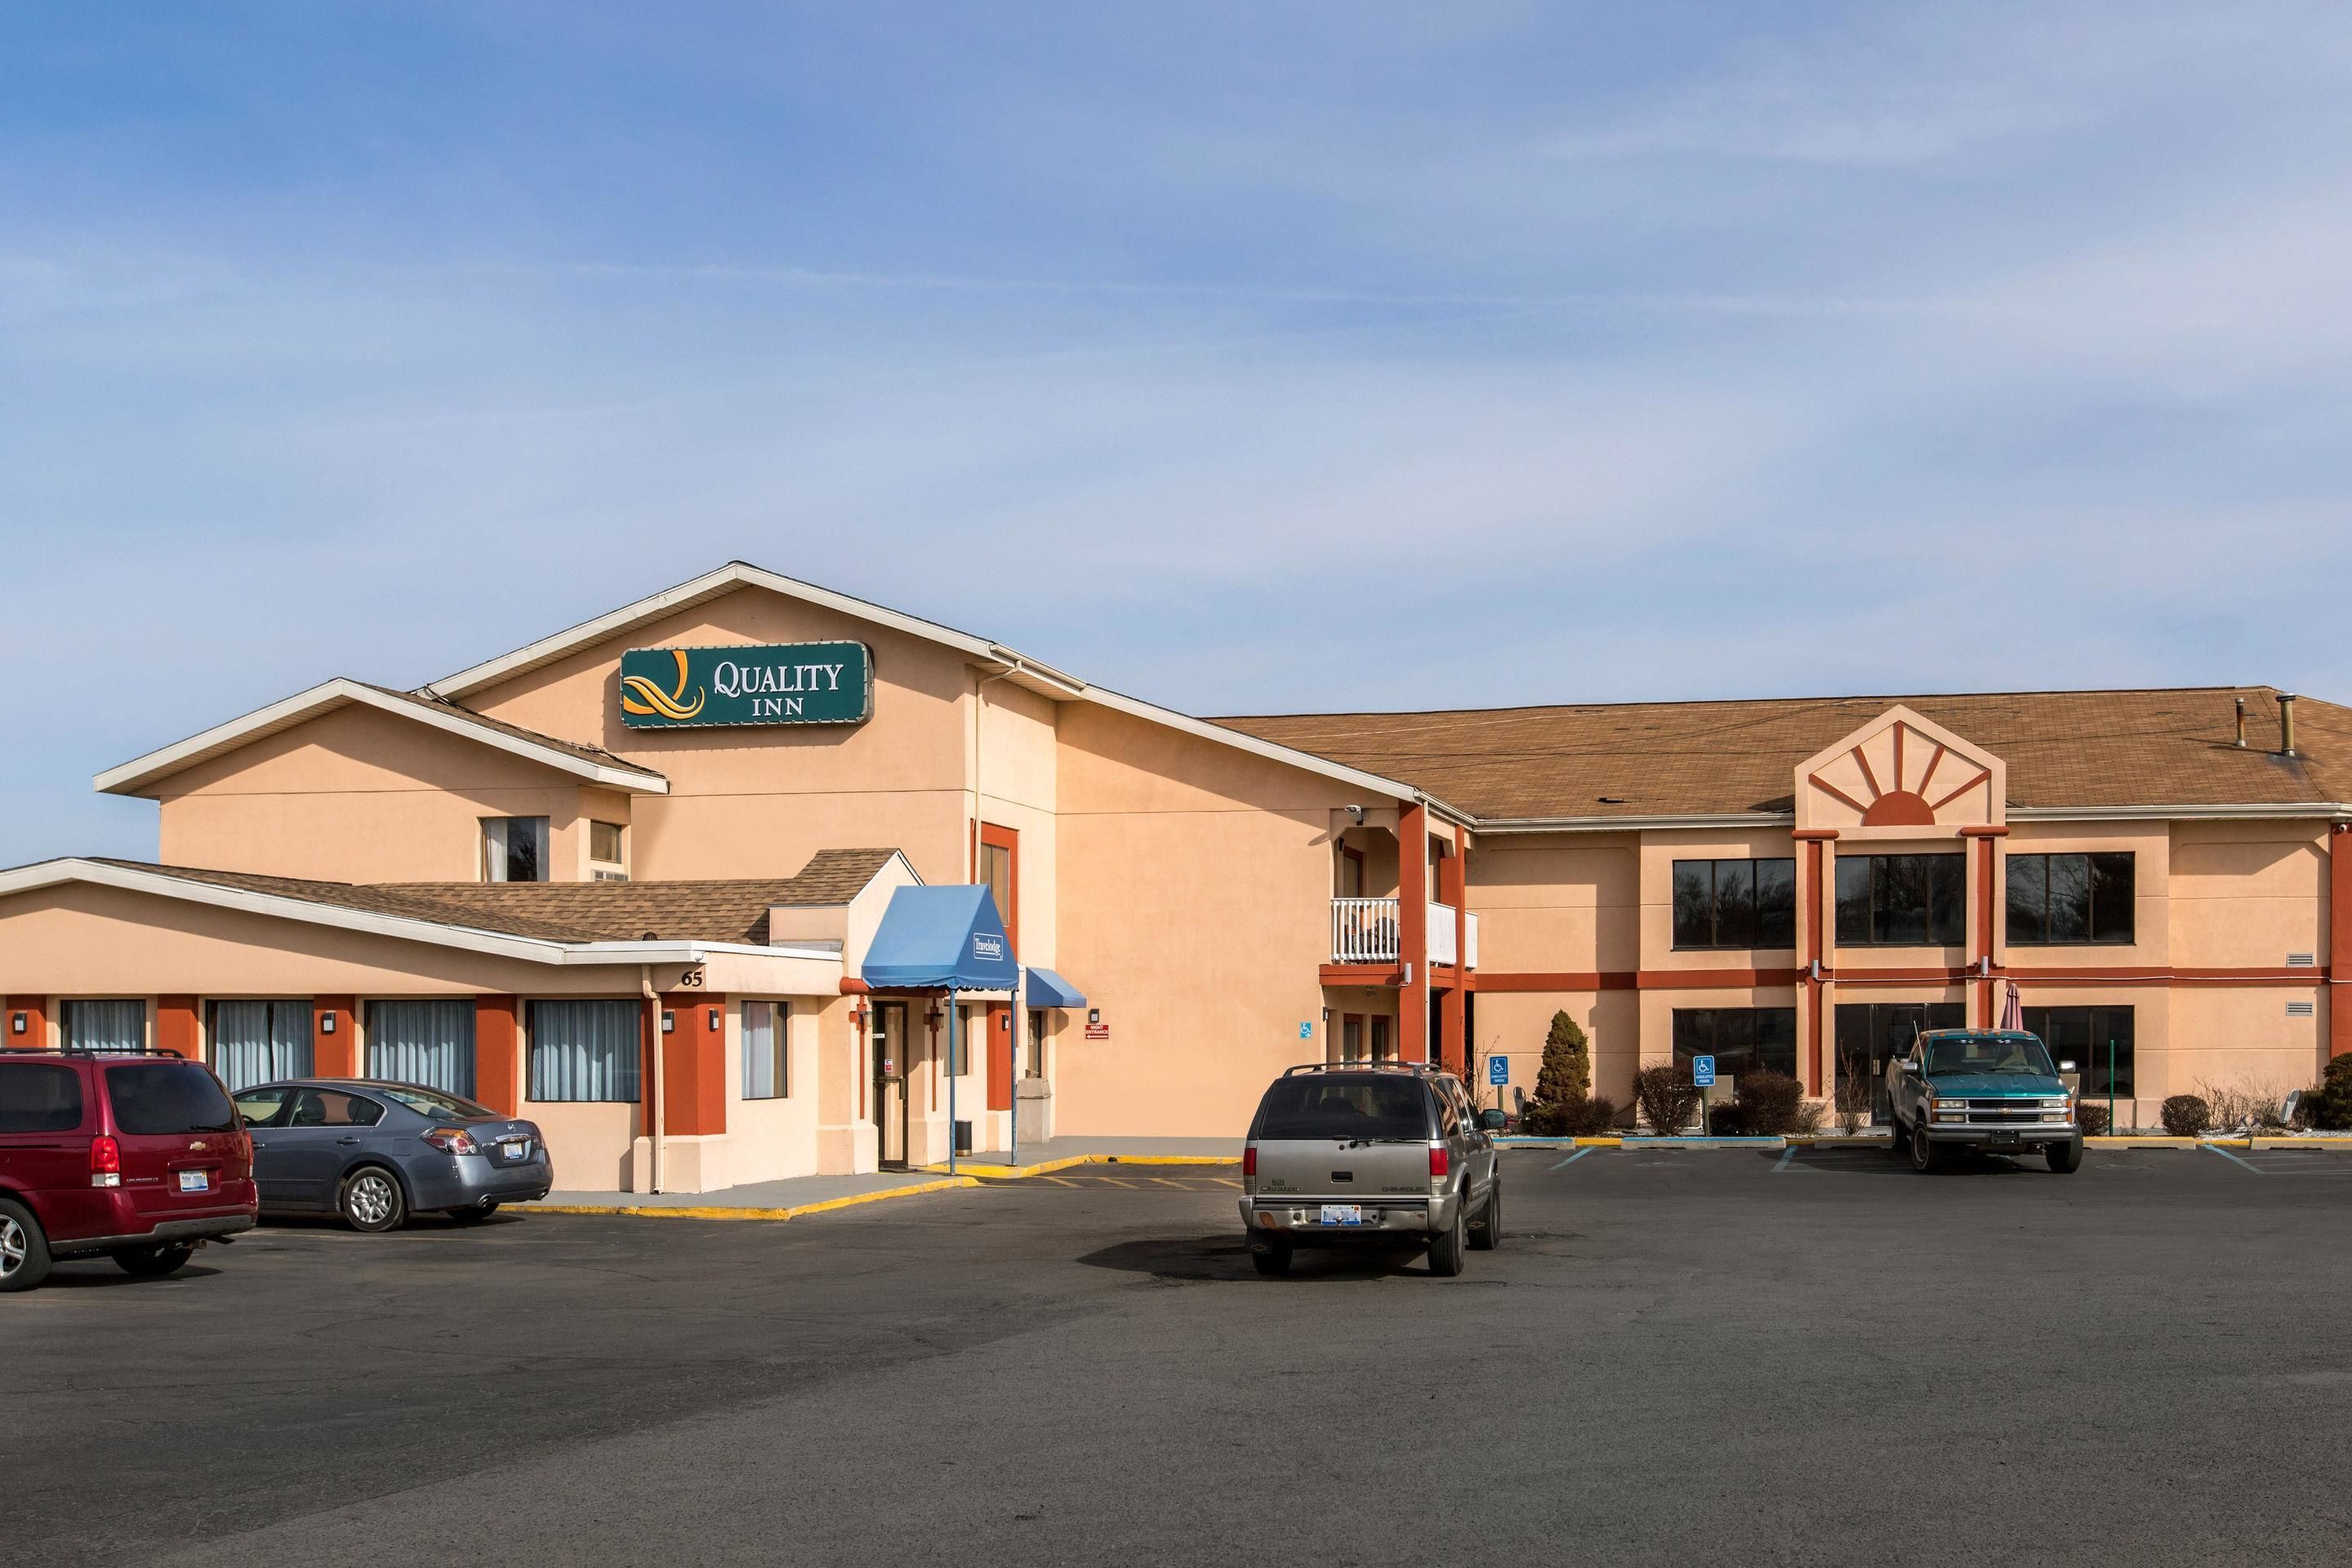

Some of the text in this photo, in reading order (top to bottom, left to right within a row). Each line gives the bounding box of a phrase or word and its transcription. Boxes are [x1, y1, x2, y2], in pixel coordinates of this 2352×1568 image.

[714, 662, 844, 697] QUALITY
[752, 697, 804, 717] INN
[974, 938, 1001, 956] Travelodge
[681, 970, 702, 987] 65
